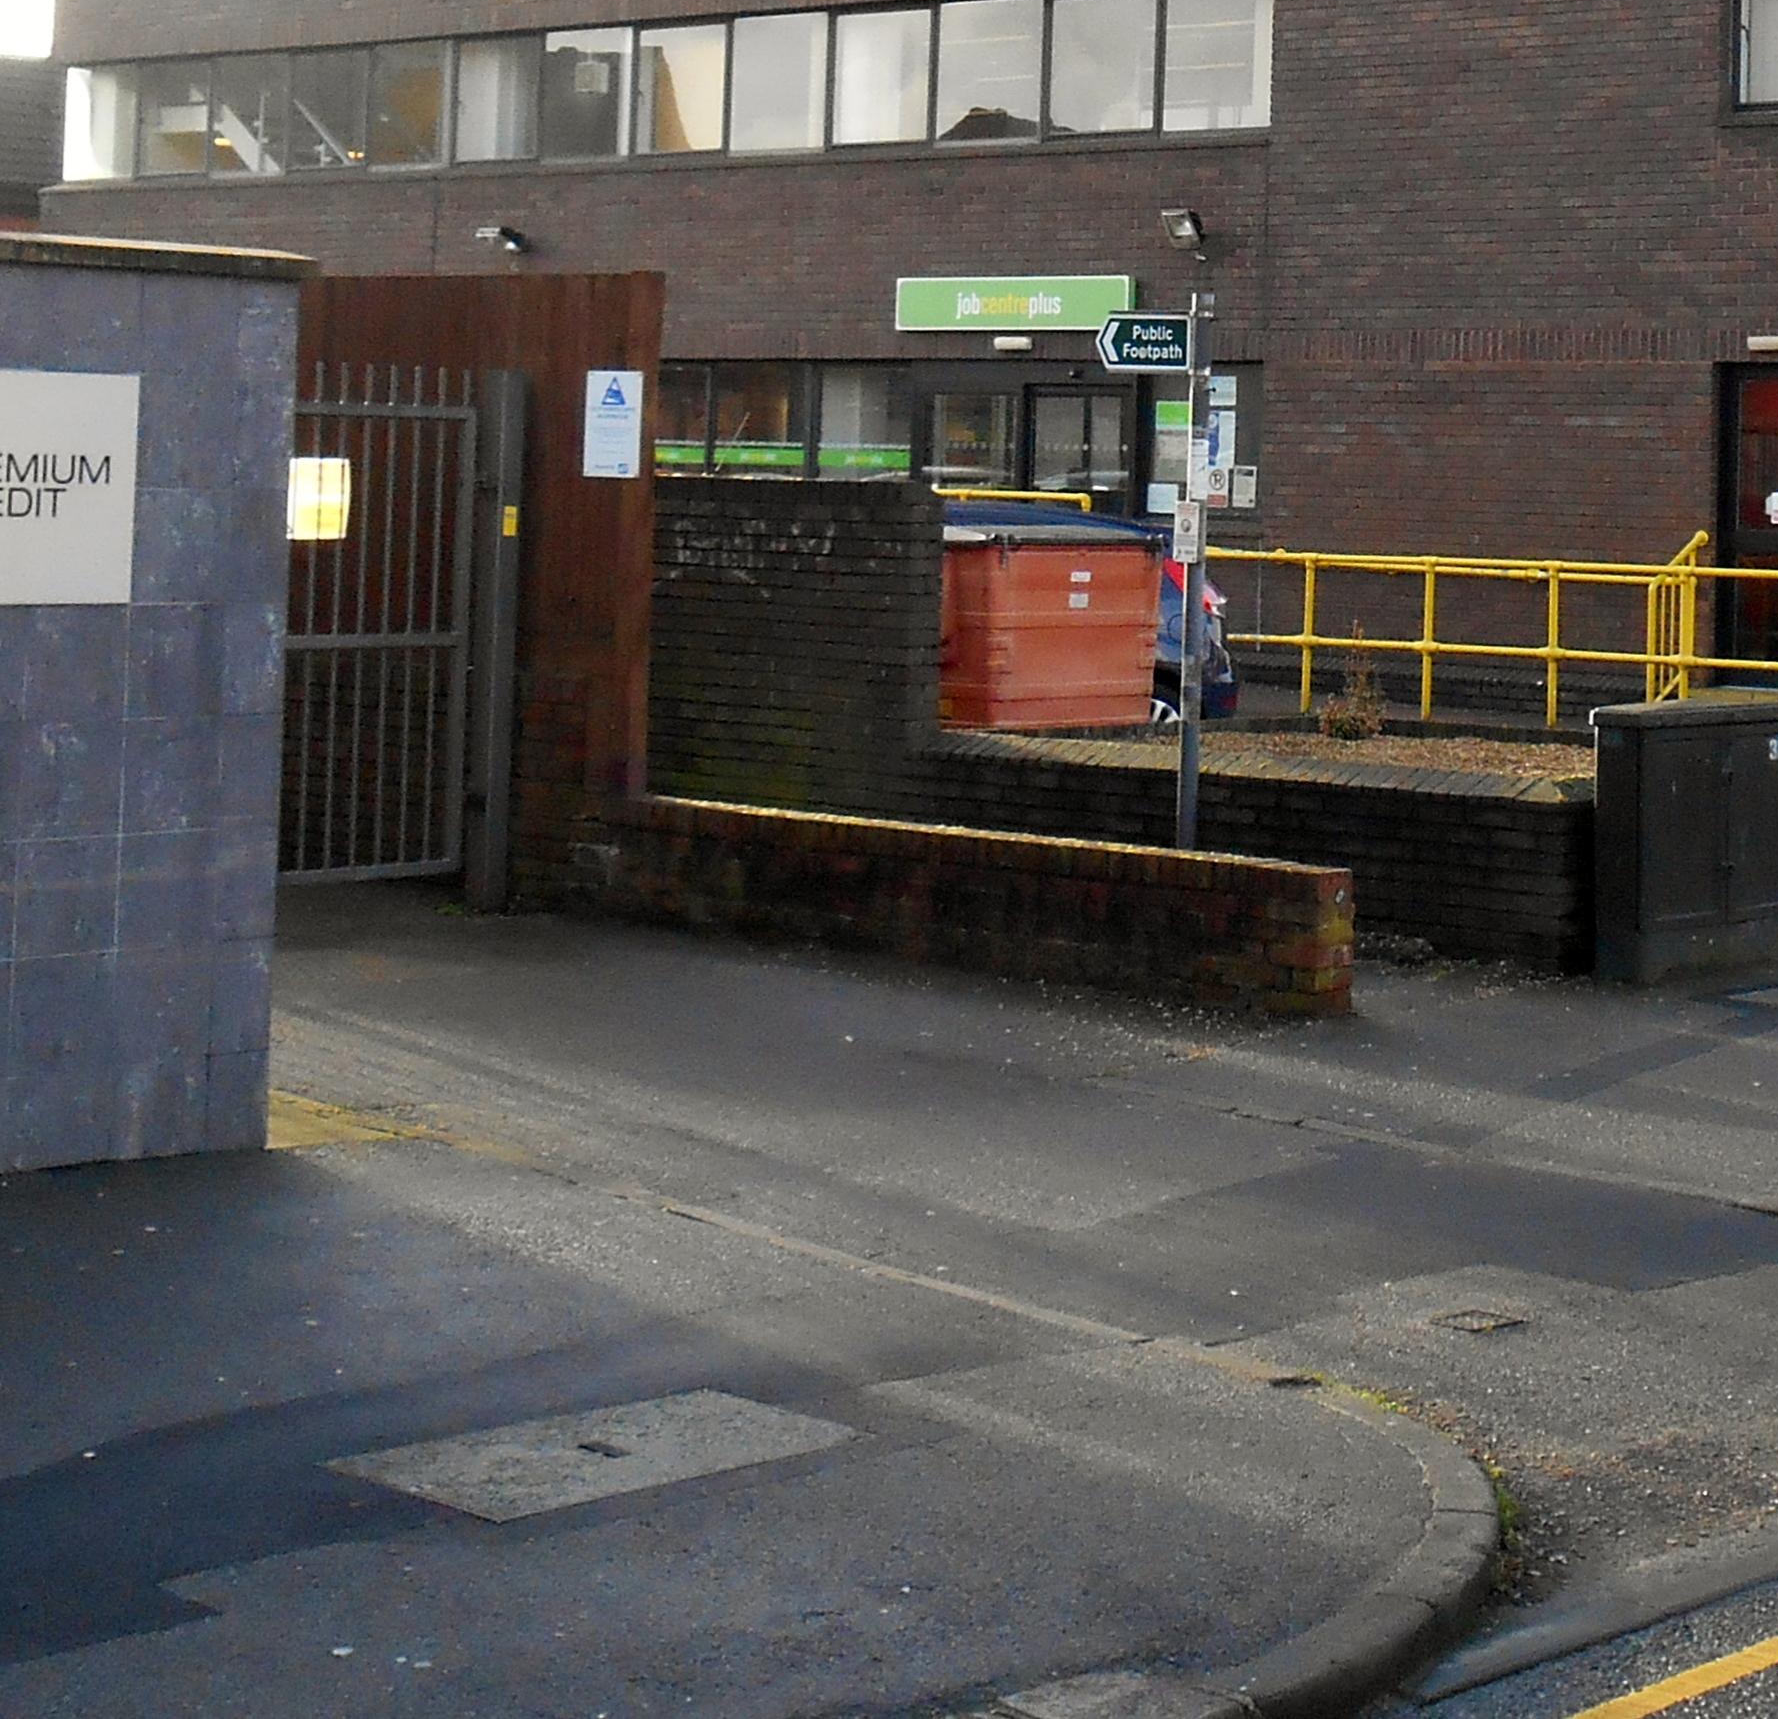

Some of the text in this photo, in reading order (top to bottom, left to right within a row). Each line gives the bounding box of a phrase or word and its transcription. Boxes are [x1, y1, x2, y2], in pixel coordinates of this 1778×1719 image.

[1132, 324, 1173, 341] Public
[1123, 343, 1182, 361] Footpath
[0, 452, 111, 484] MIUM
[0, 487, 67, 518] DIT
